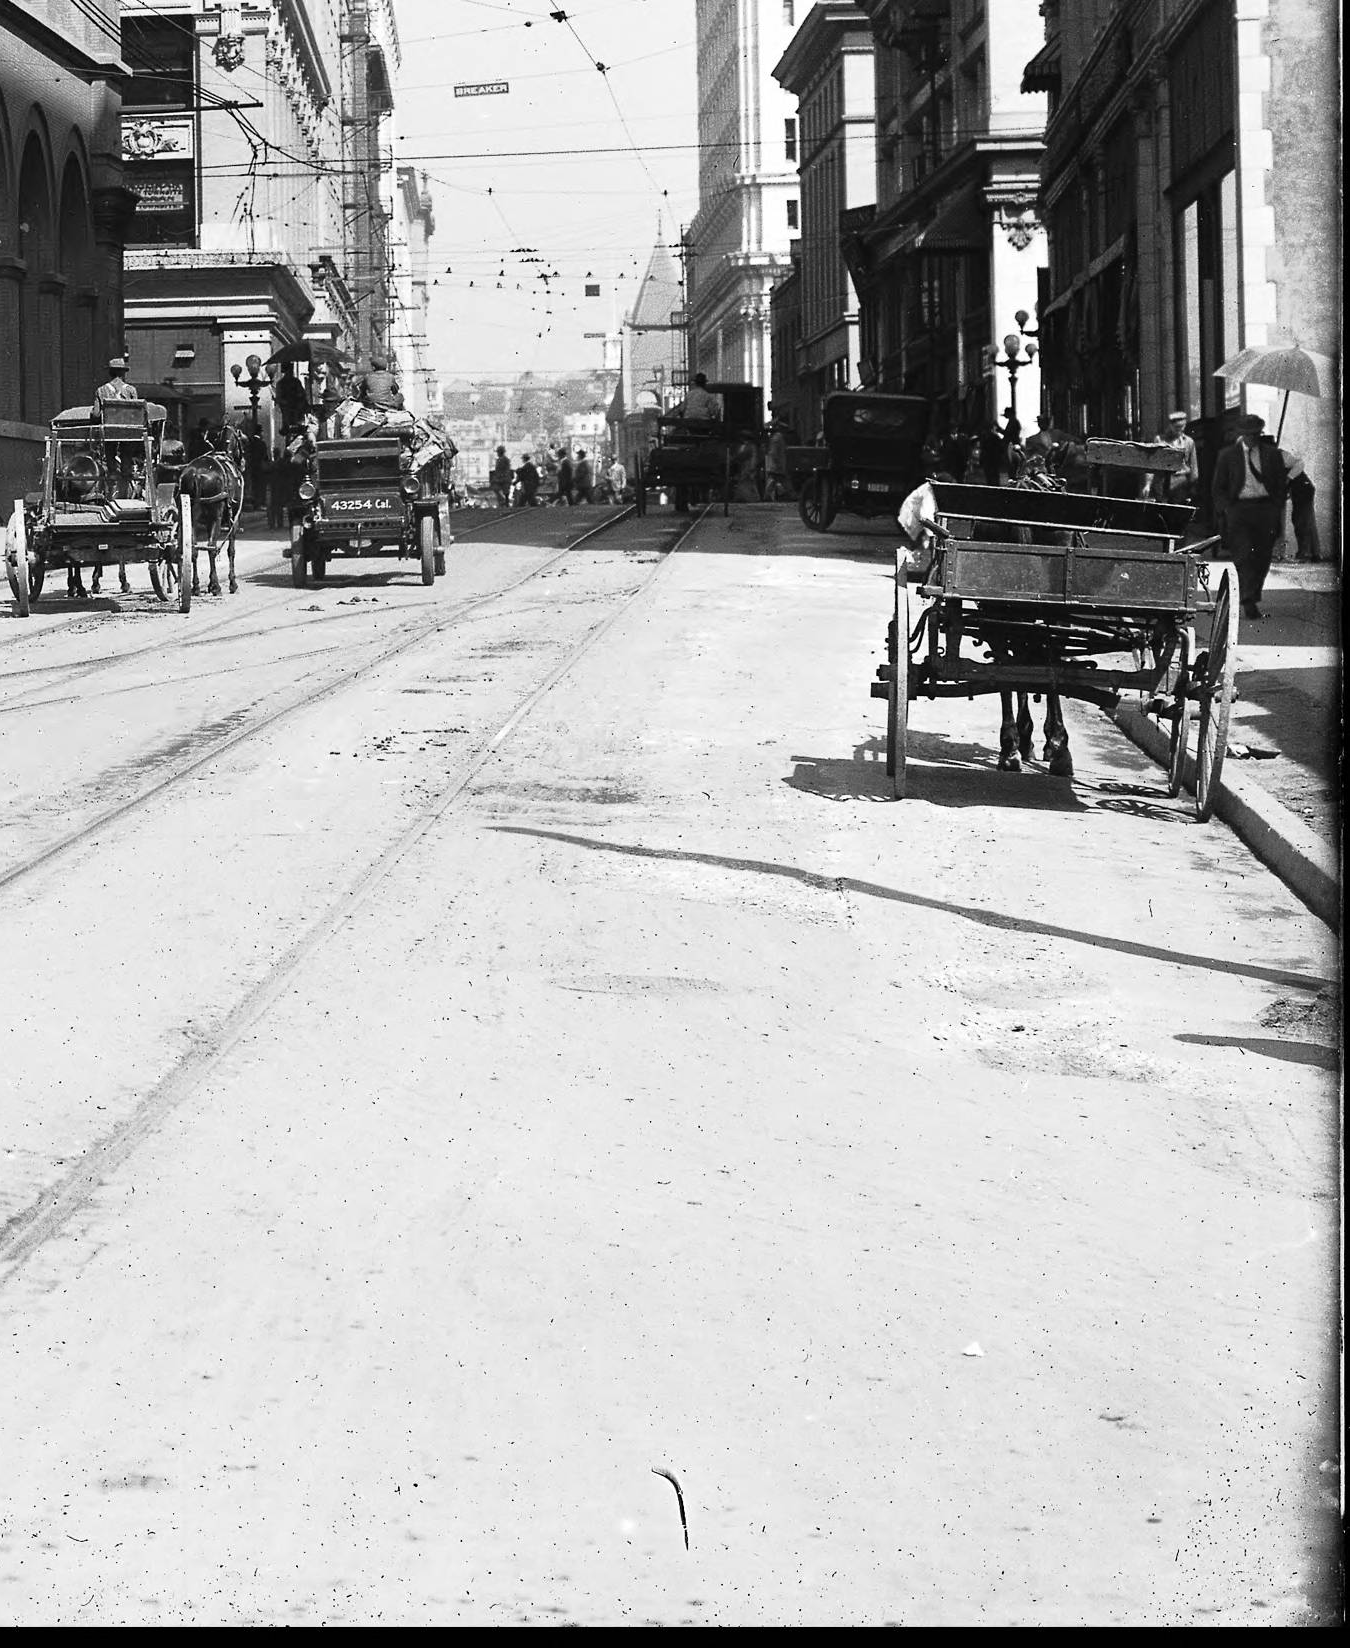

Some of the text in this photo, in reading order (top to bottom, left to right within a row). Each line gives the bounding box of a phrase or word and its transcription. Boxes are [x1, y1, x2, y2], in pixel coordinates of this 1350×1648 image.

[456, 84, 507, 95] BREAKER
[331, 498, 392, 511] 43254 Cal.
